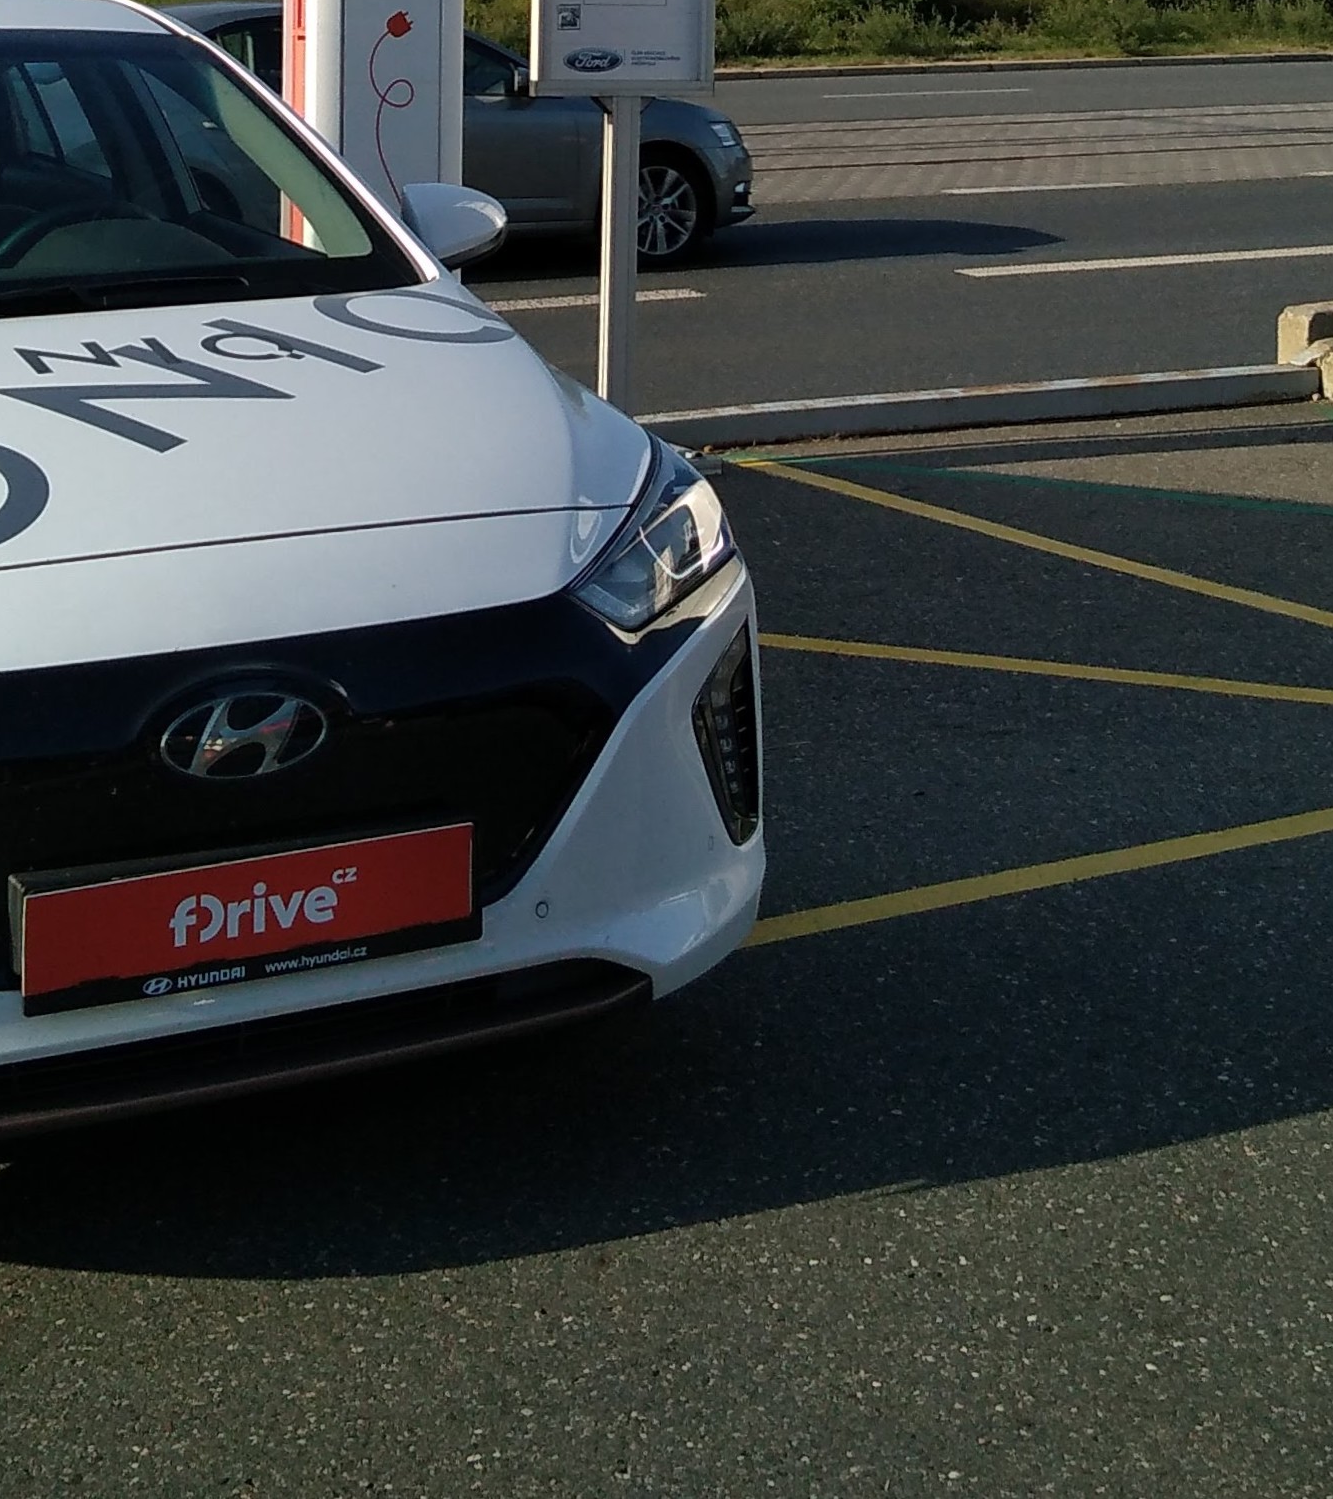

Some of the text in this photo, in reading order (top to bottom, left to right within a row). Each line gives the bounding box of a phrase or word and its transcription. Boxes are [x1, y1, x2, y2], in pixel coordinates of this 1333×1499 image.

[574, 51, 611, 68] Ford
[177, 945, 368, 990] HYUNDAI www.hyundai.cz
